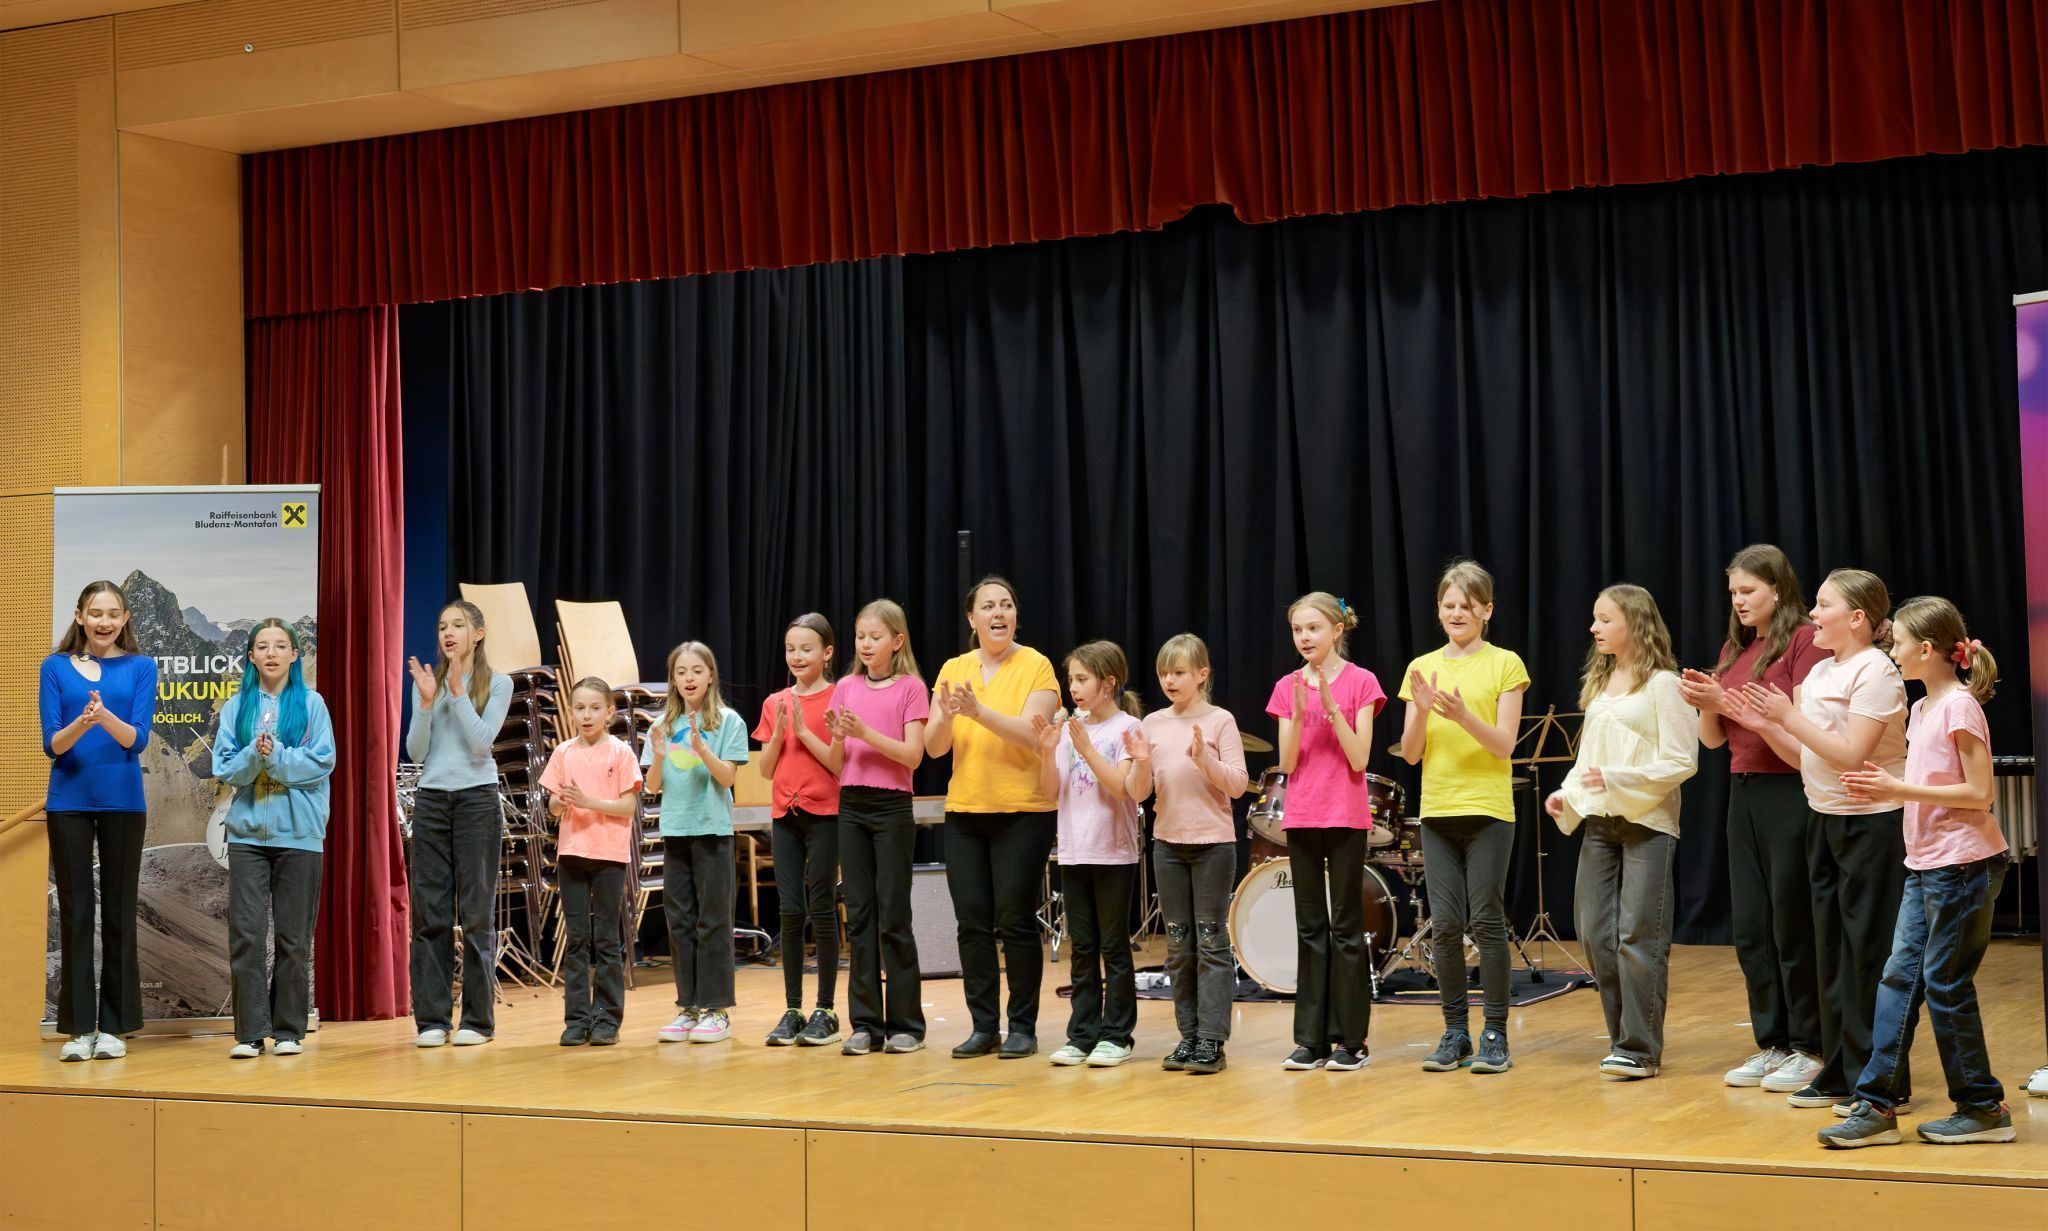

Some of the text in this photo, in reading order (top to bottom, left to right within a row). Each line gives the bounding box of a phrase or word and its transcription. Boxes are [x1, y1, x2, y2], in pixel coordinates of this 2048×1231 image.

[209, 510, 278, 520] Raiffeisenbank
[194, 519, 278, 529] Bludenz-Montafon
[155, 681, 241, 701] UKUNF
